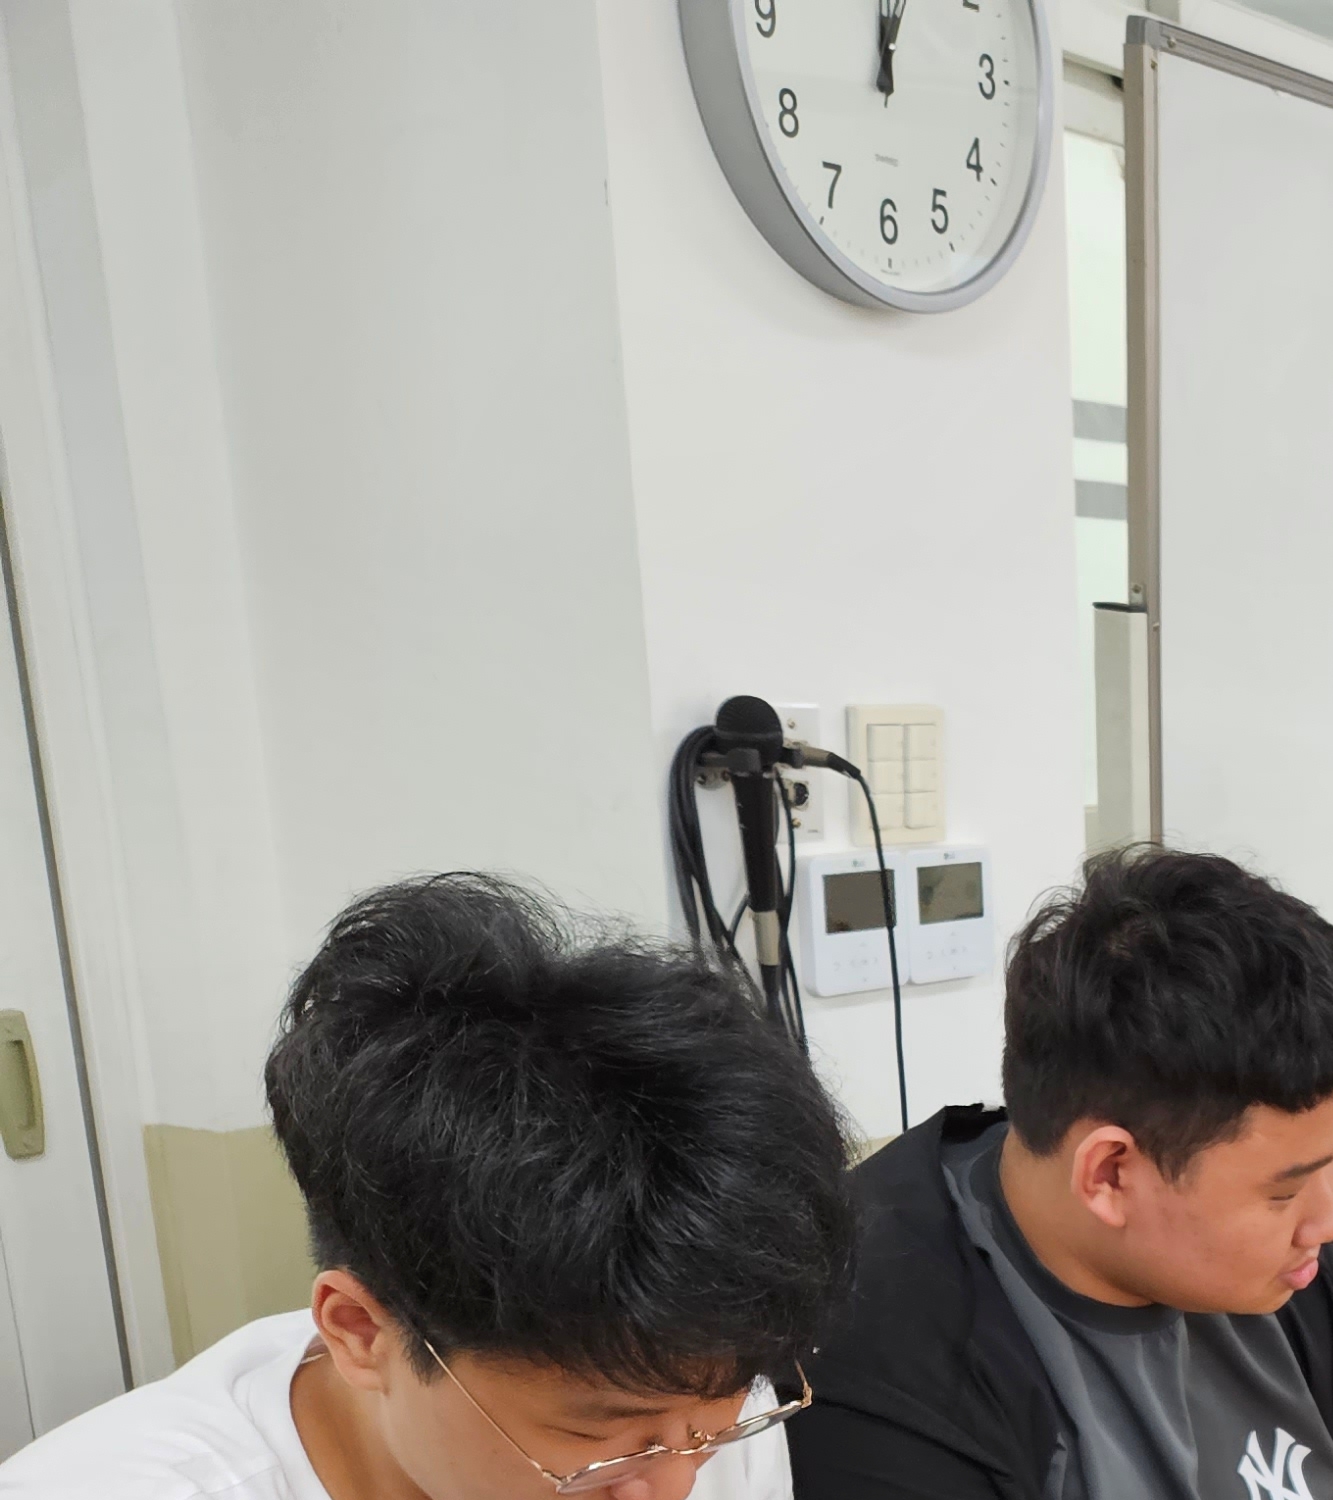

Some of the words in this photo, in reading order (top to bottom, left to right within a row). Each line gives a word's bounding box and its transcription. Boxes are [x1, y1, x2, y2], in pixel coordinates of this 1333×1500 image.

[978, 53, 996, 100] 3
[778, 88, 799, 138] 8
[966, 137, 983, 182] 4
[822, 161, 842, 209] 7
[879, 198, 898, 245] 6
[931, 188, 949, 234] 5
